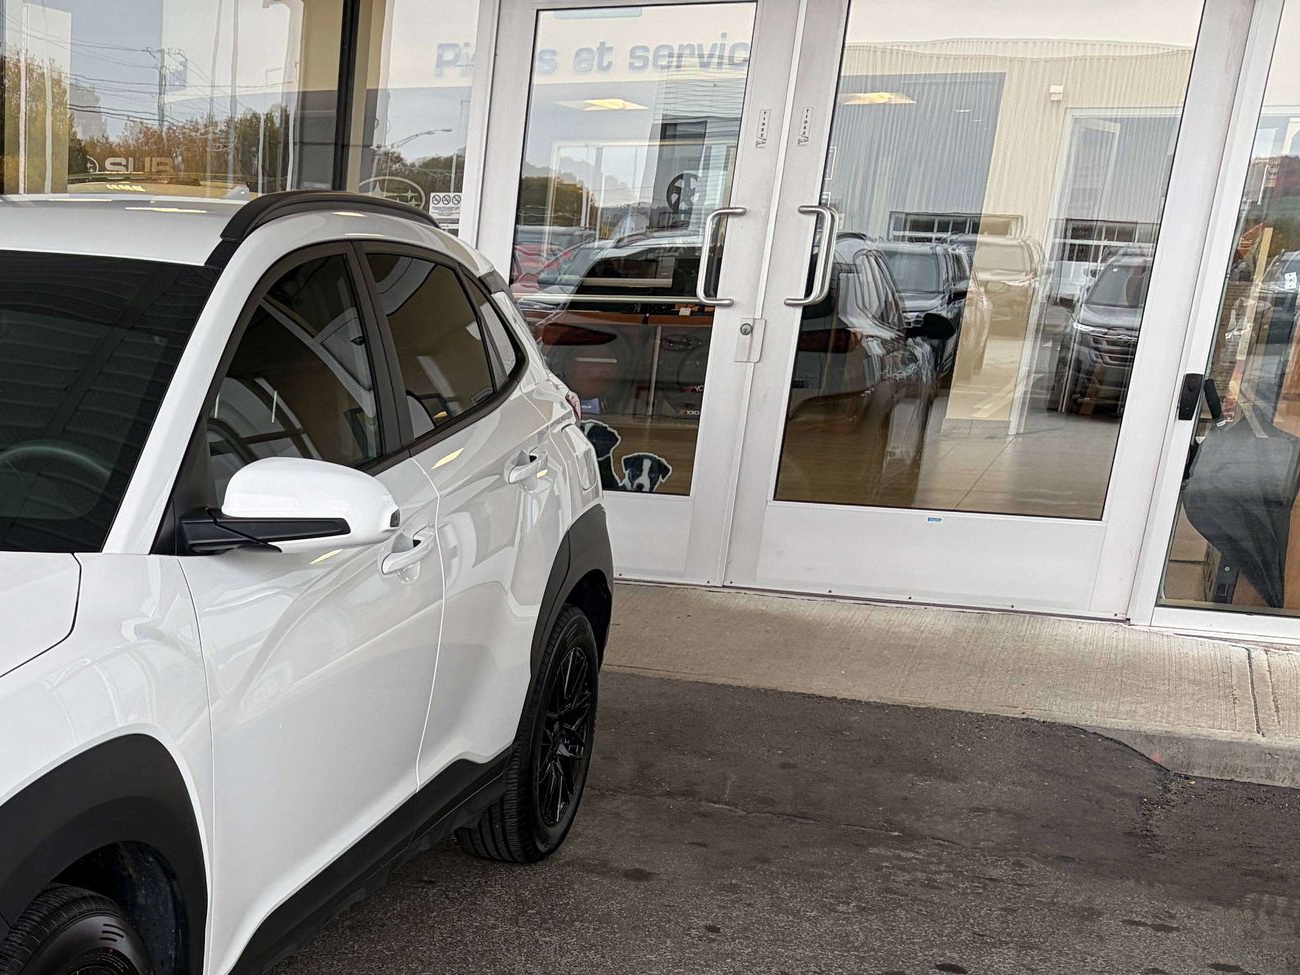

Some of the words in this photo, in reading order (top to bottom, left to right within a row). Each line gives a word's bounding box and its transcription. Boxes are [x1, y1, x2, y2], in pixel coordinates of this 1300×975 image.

[434, 42, 557, 77] Pis
[573, 41, 614, 74] et
[628, 32, 749, 72] servic
